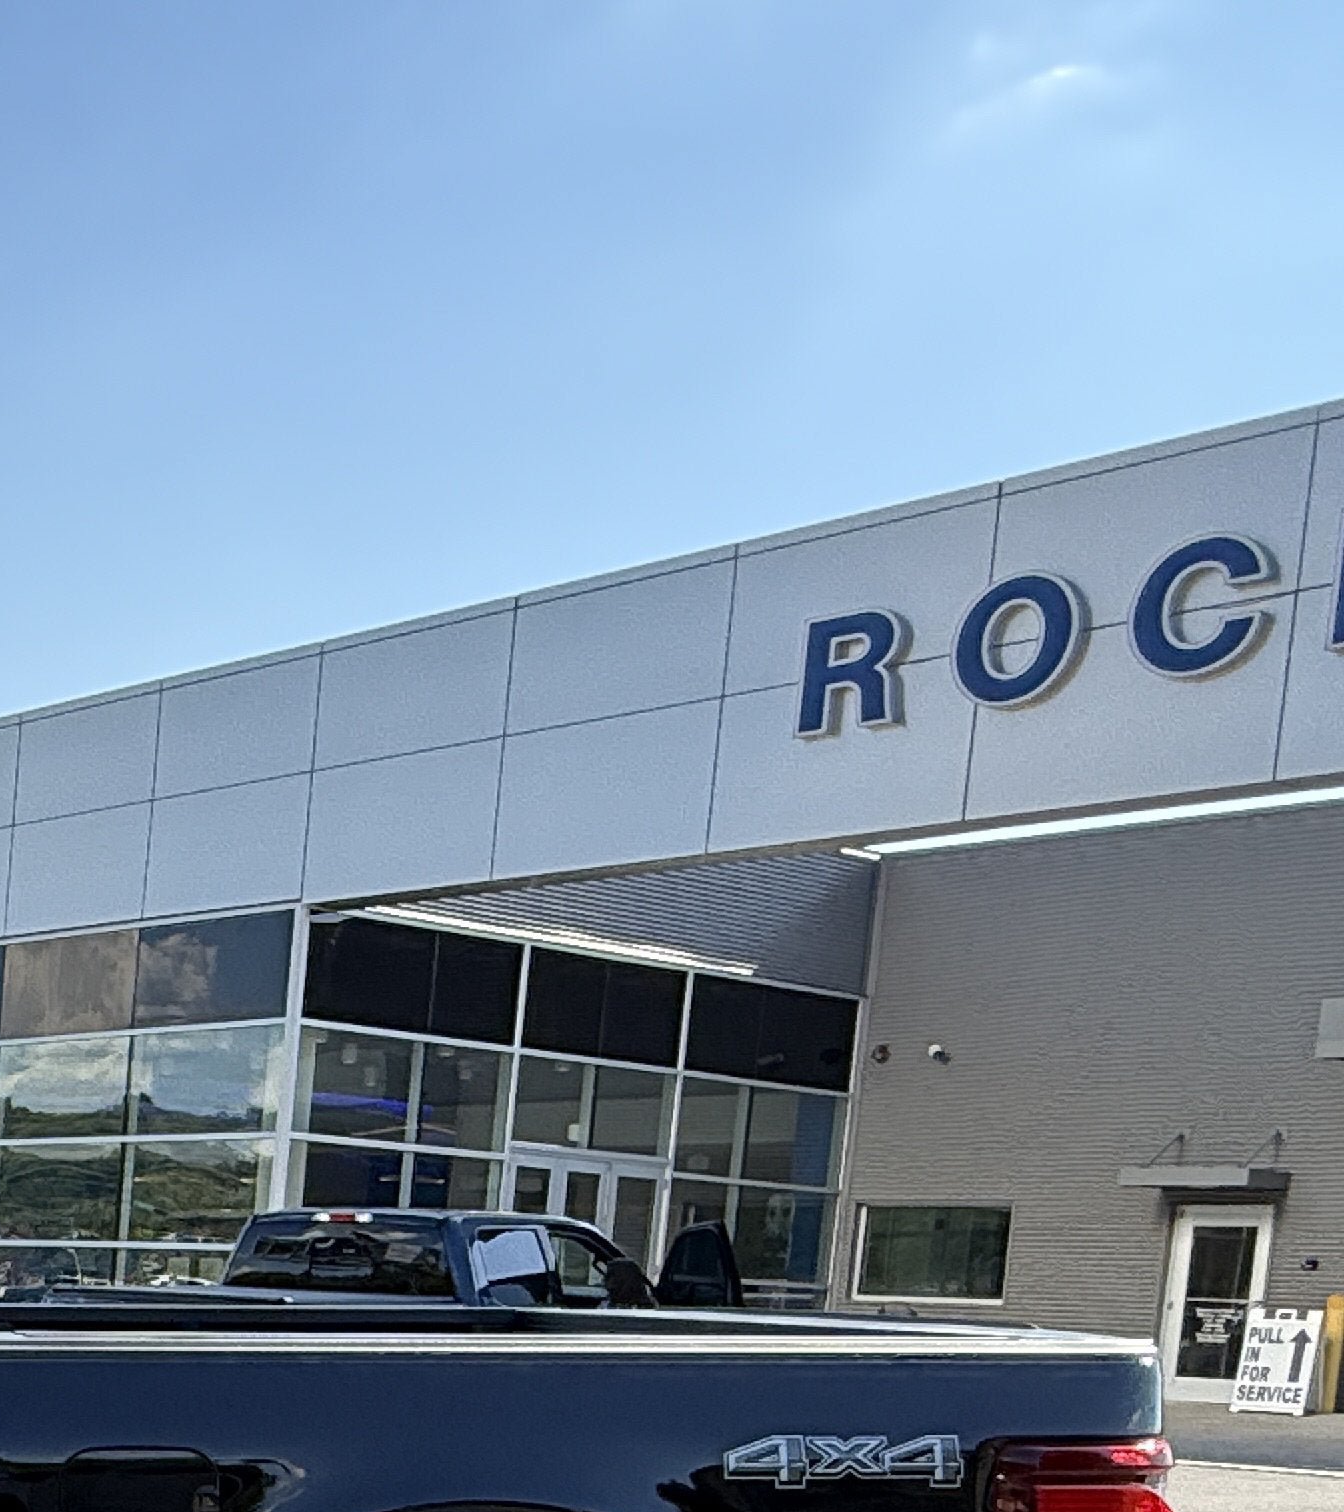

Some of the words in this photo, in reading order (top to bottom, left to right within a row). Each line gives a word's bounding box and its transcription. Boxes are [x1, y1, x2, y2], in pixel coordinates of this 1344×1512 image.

[793, 512, 1344, 740] ROC
[1249, 1327, 1285, 1344] PULL
[1245, 1347, 1261, 1362] IN
[1240, 1365, 1272, 1382] FOR
[1236, 1385, 1303, 1404] SERVICE
